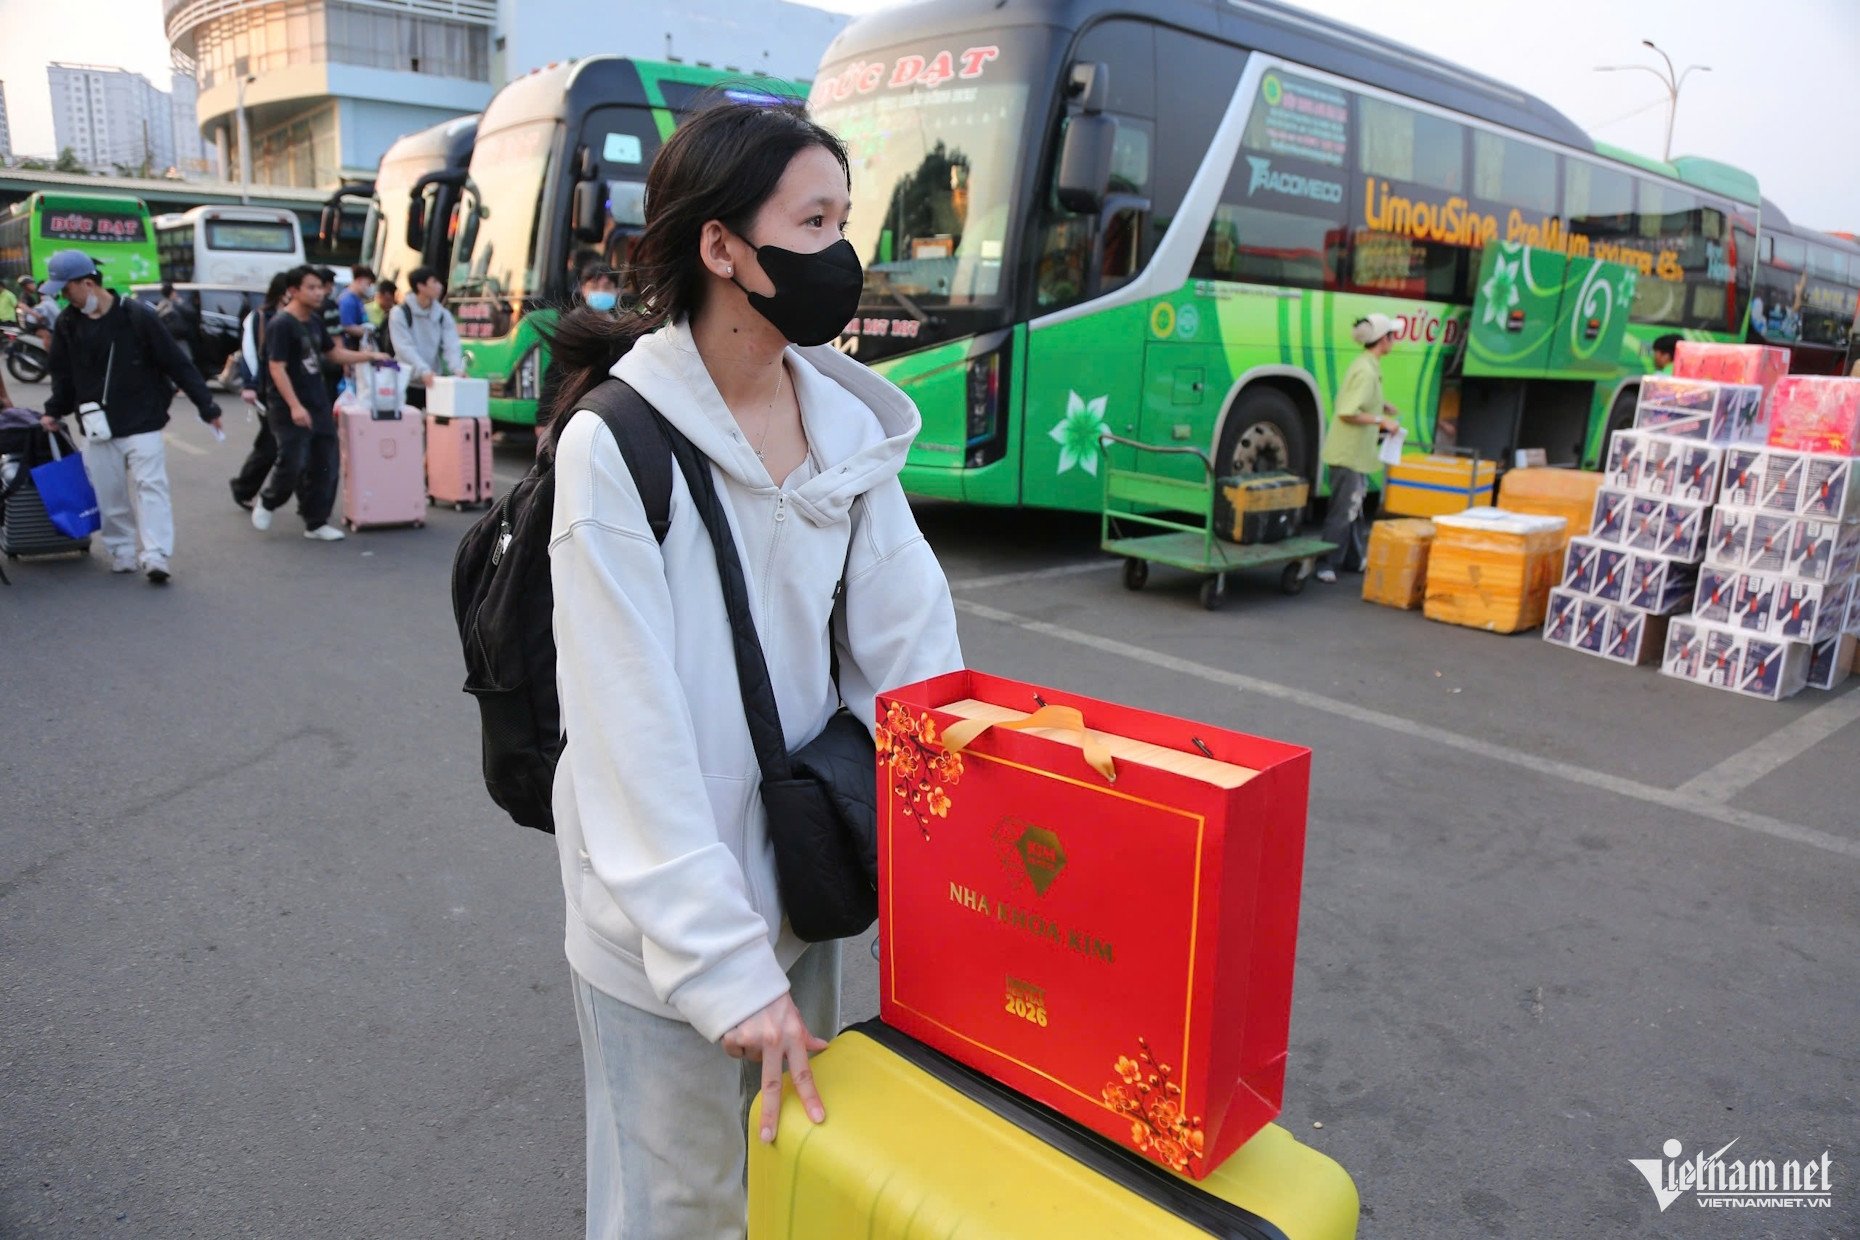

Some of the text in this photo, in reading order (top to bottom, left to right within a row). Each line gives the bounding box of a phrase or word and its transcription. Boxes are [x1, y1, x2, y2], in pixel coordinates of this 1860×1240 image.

[949, 881, 1114, 964] NHA KHOA KIM
[1005, 993, 1048, 1028] 2026
